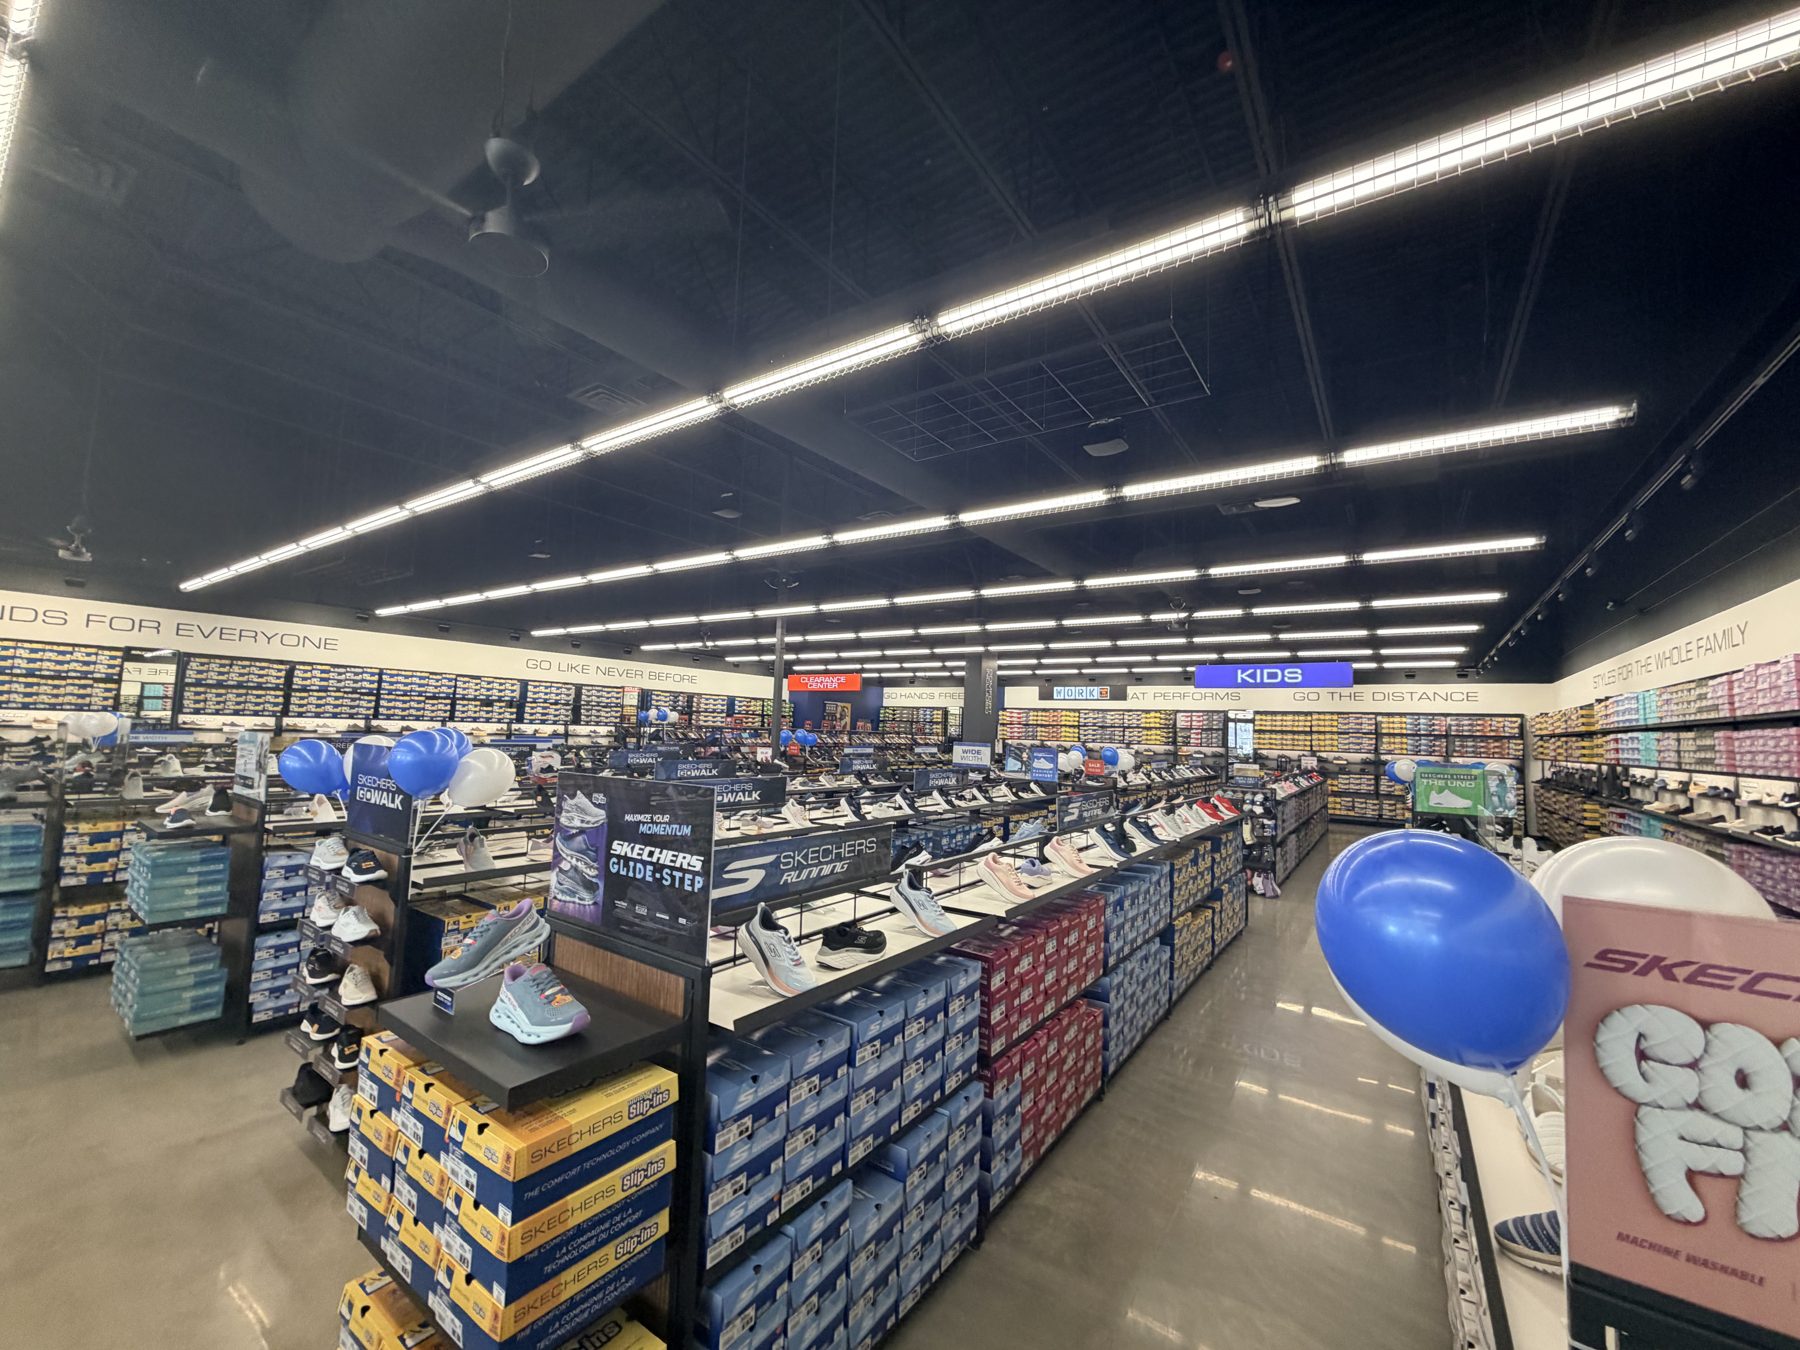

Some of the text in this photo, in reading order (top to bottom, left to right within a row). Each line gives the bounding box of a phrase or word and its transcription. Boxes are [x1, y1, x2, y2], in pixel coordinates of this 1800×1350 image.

[0, 604, 340, 651] DS FOR EVERYONE
[1592, 620, 1749, 690] STYLES FOR THE WHOLE FAMILY
[525, 658, 698, 684] GO LIKE NEVER BEFORE
[800, 675, 846, 684] CLEARANCE
[1237, 668, 1303, 684] KIDS
[807, 682, 839, 690] CENTER
[899, 691, 935, 700] HANDS
[938, 691, 964, 700] FREE
[1055, 688, 1096, 698] WORK
[1127, 691, 1241, 701] AT PERFORMS
[1292, 691, 1480, 702] GO THE DISTANCE
[959, 753, 984, 763] WIDTH
[960, 747, 983, 757] WIDE
[677, 762, 713, 770] SKECHERS
[357, 773, 397, 791] SKECHERS
[716, 782, 754, 793] ECHERS
[1421, 779, 1476, 788] THE UNO
[624, 813, 671, 823] MAXIMIZE YOUR
[638, 823, 692, 837] MOMENTUM
[610, 840, 705, 872] SKECHERS
[780, 837, 877, 871] SKECHERS
[609, 857, 705, 893] GLIDE-STEP
[779, 859, 850, 886] RUNNING
[1583, 947, 1800, 1003] SKEC
[530, 1110, 624, 1165] SKECHERS
[628, 1089, 670, 1121] Slip-ins
[523, 1186, 540, 1201] THE
[541, 1164, 582, 1193] COMFORT
[582, 1141, 632, 1170] TECHNOLOGY
[631, 1122, 665, 1146] COMPANY
[520, 1157, 666, 1246] SKECHERS Slip-ins
[543, 1208, 644, 1275] TECHNOLOGIE DU CONFORT
[556, 1207, 633, 1259] LA COMPAGNIE DE LA
[514, 1252, 610, 1324] SKECHERS
[615, 1221, 659, 1261] Slip-ins
[1616, 1231, 1767, 1288] MACHINE WASHABLE
[603, 1275, 637, 1306] CONFORT
[548, 1321, 560, 1334] LA
[561, 1291, 605, 1325] COMPAGNIE
